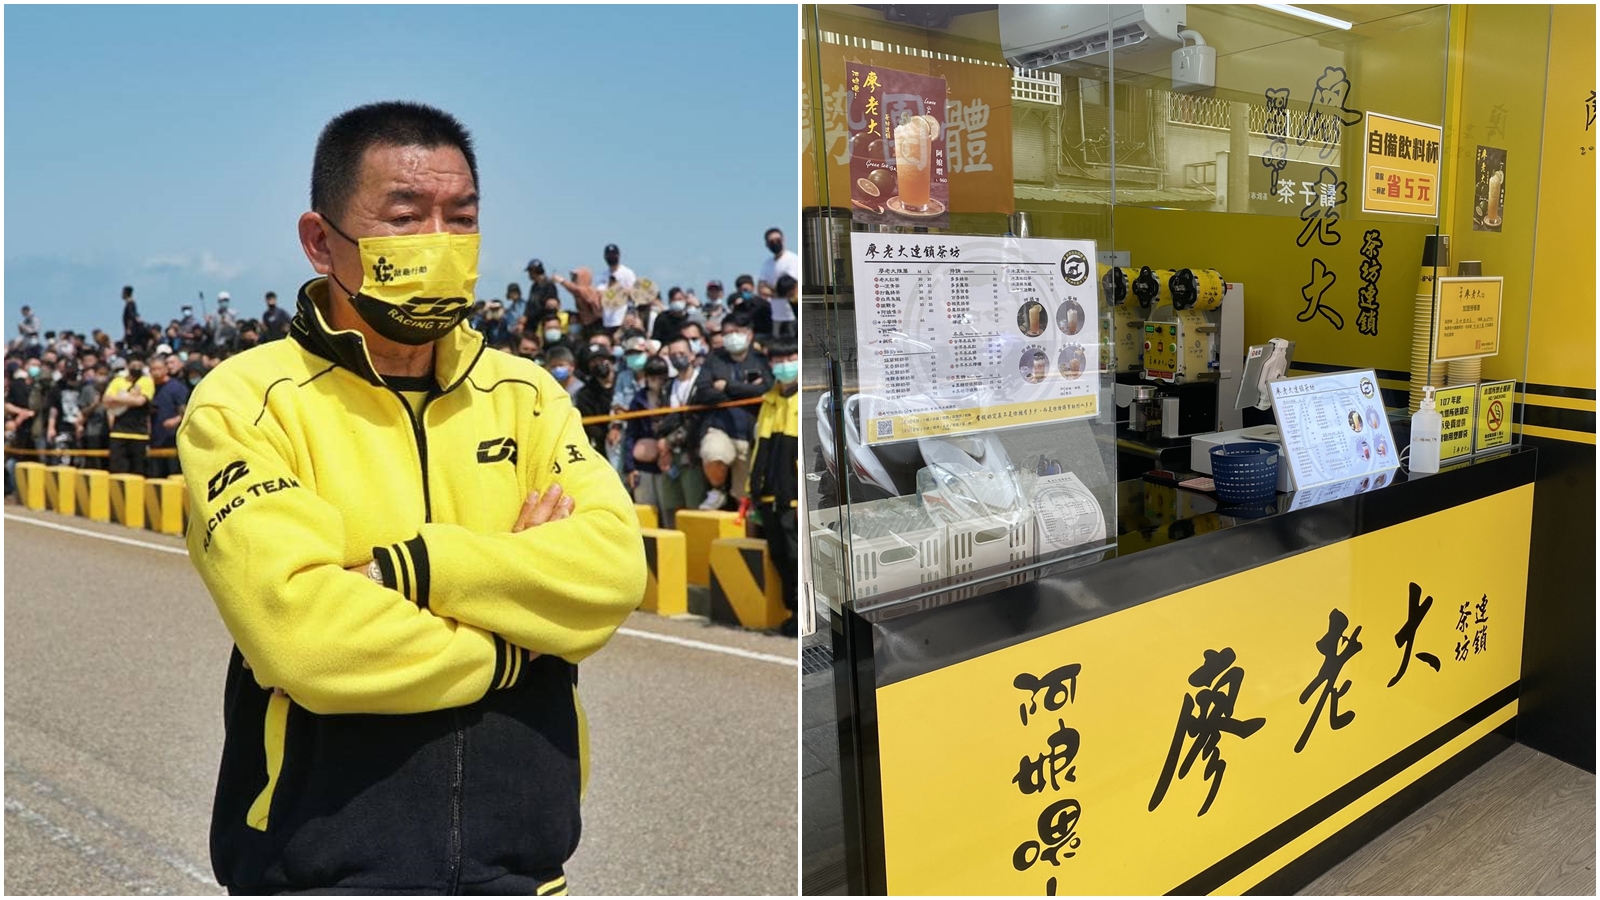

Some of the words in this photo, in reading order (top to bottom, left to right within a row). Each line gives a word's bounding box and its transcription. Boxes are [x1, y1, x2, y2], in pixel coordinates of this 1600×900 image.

[863, 71, 882, 137] 廖老大
[1369, 130, 1439, 164] 自備飲料杯
[866, 243, 960, 259] 廖老大連鎖茶坊
[1356, 228, 1383, 336] 茶坊連鎖
[388, 309, 434, 329] RACING
[204, 496, 245, 553] RACING
[1454, 601, 1472, 662] 茶坊
[1473, 594, 1489, 655] 連鎖
[1147, 582, 1441, 817] 廖老大
